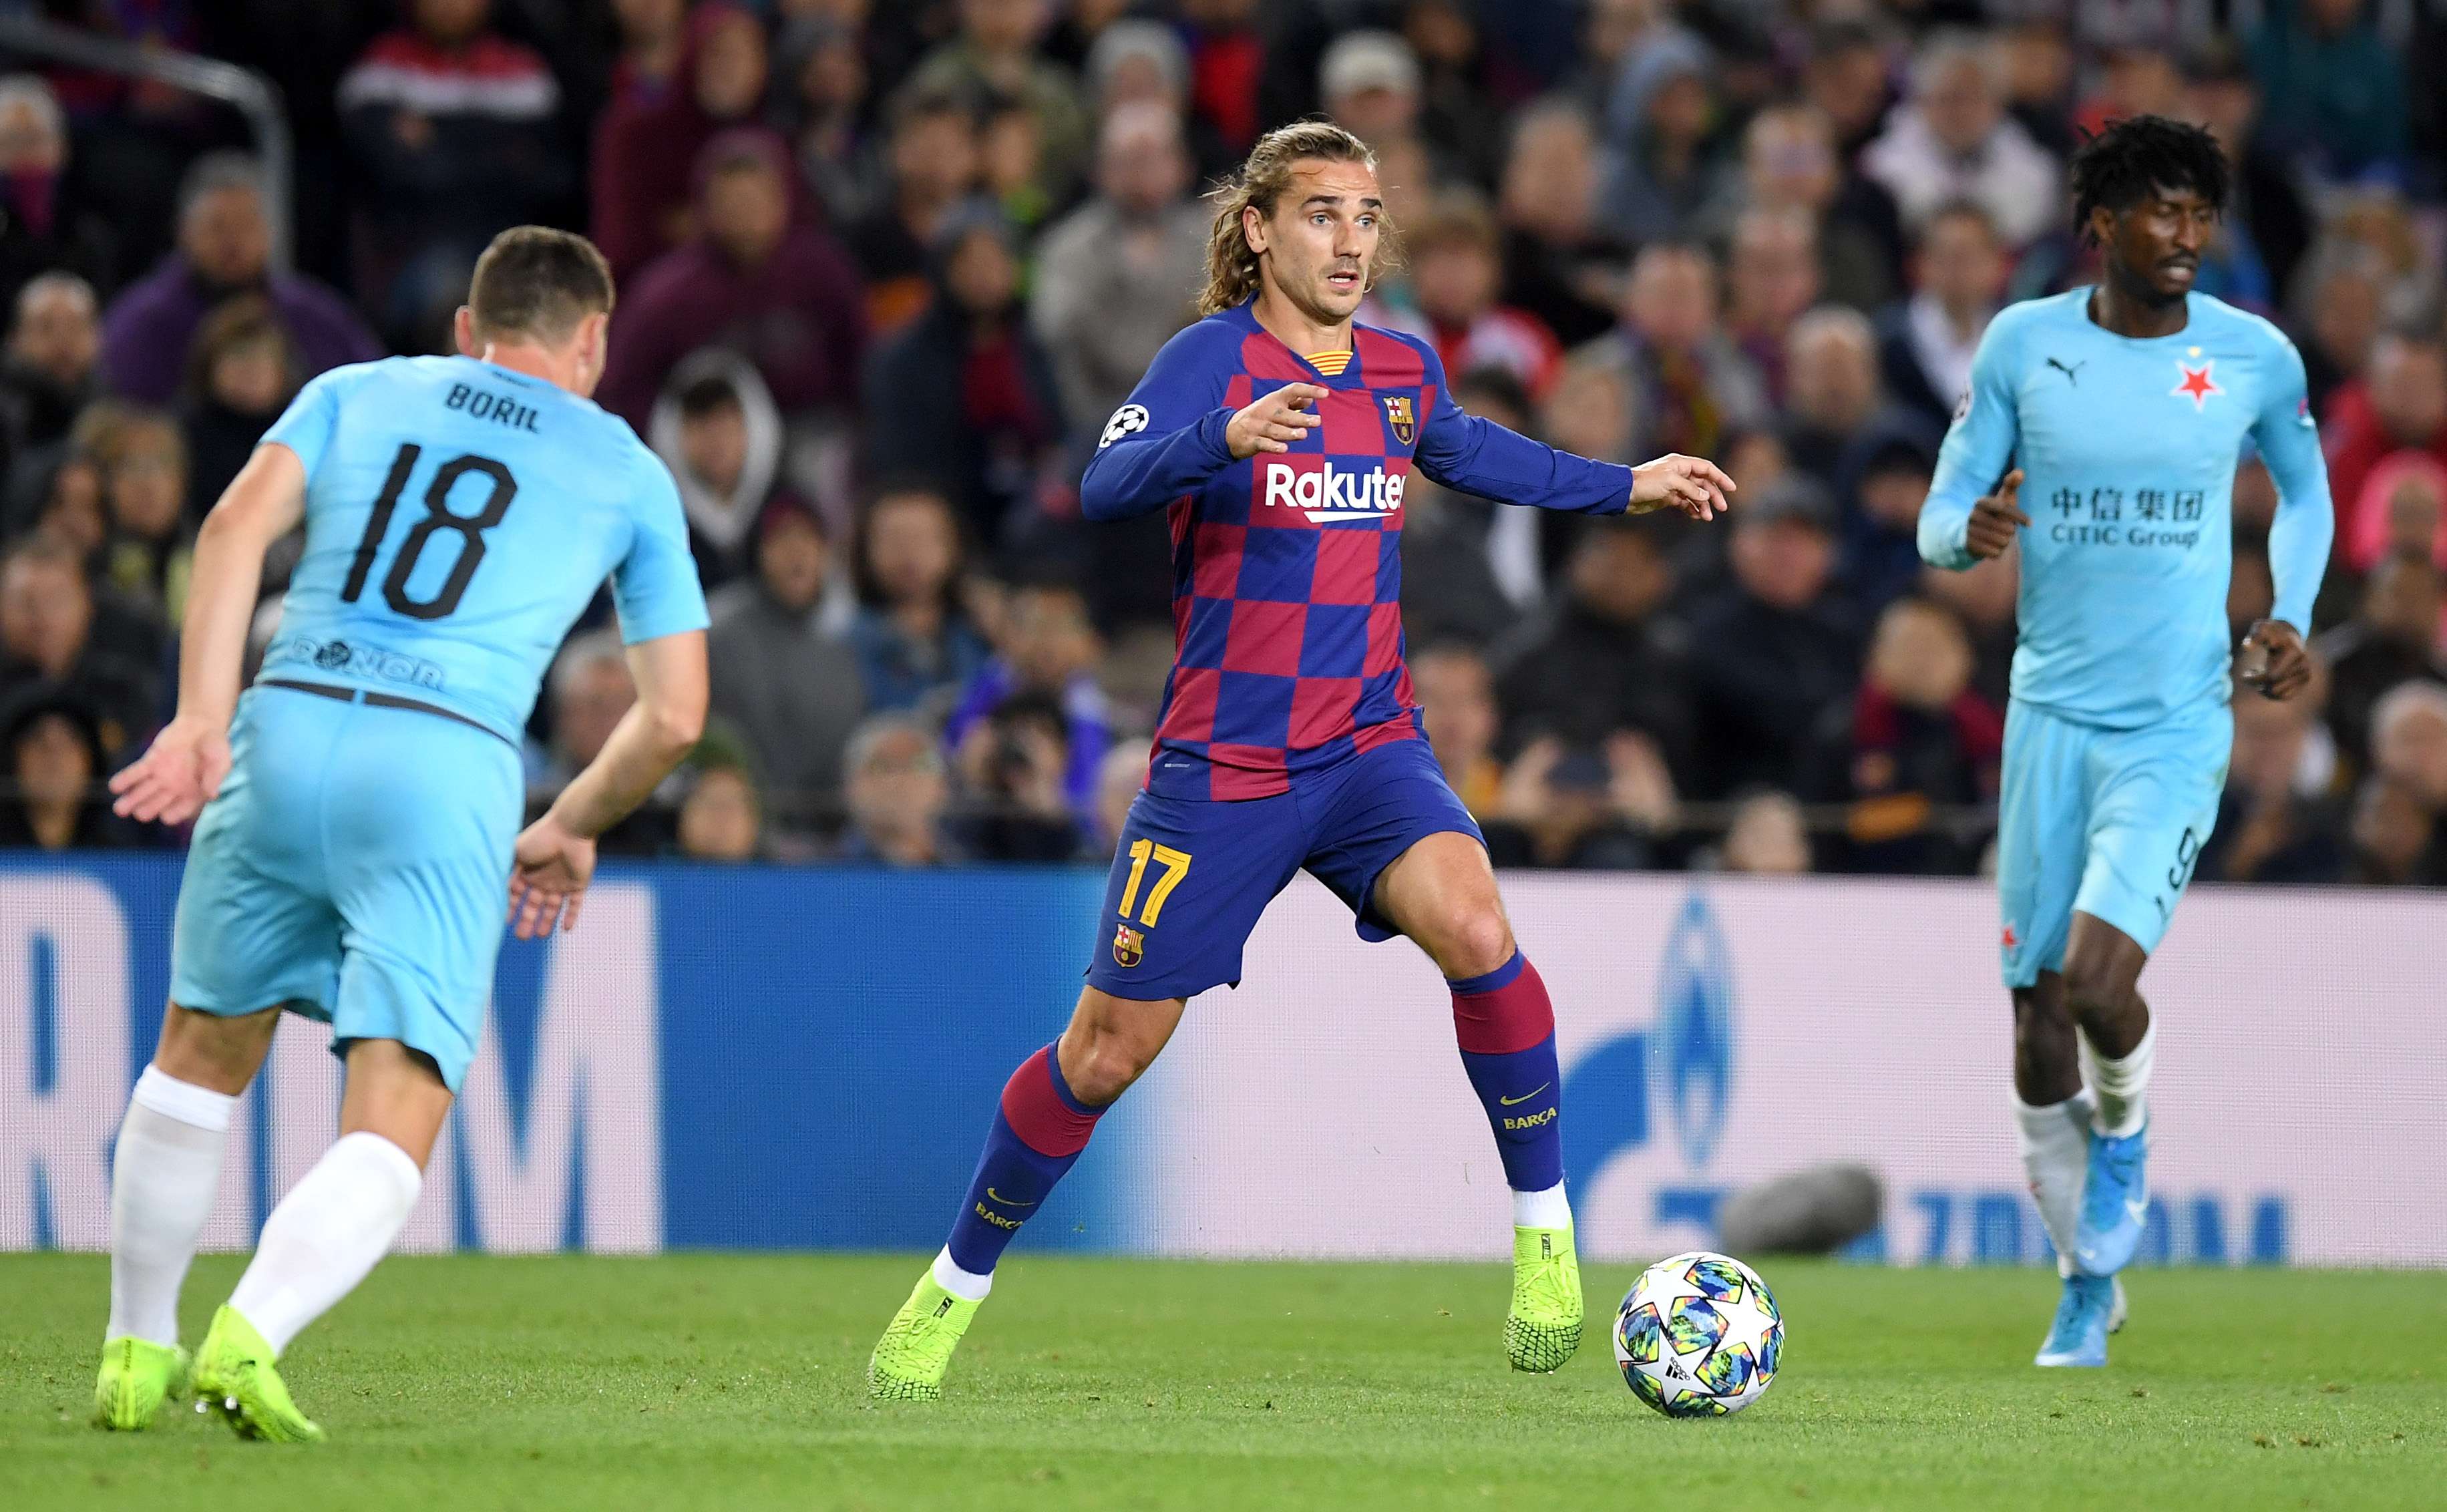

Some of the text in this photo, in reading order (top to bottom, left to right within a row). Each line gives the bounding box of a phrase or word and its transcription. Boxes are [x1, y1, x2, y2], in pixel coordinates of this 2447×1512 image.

[446, 382, 540, 434] BOŘIL
[1265, 461, 1406, 510] Rakute
[2052, 486, 2203, 522] 中信集团
[341, 443, 518, 621] 18
[2051, 523, 2199, 552] CITIC Group
[2169, 826, 2199, 890] 9
[1118, 838, 1192, 928] 17
[1503, 1107, 1557, 1130] BARÇA
[1670, 1356, 1691, 1381] adidas
